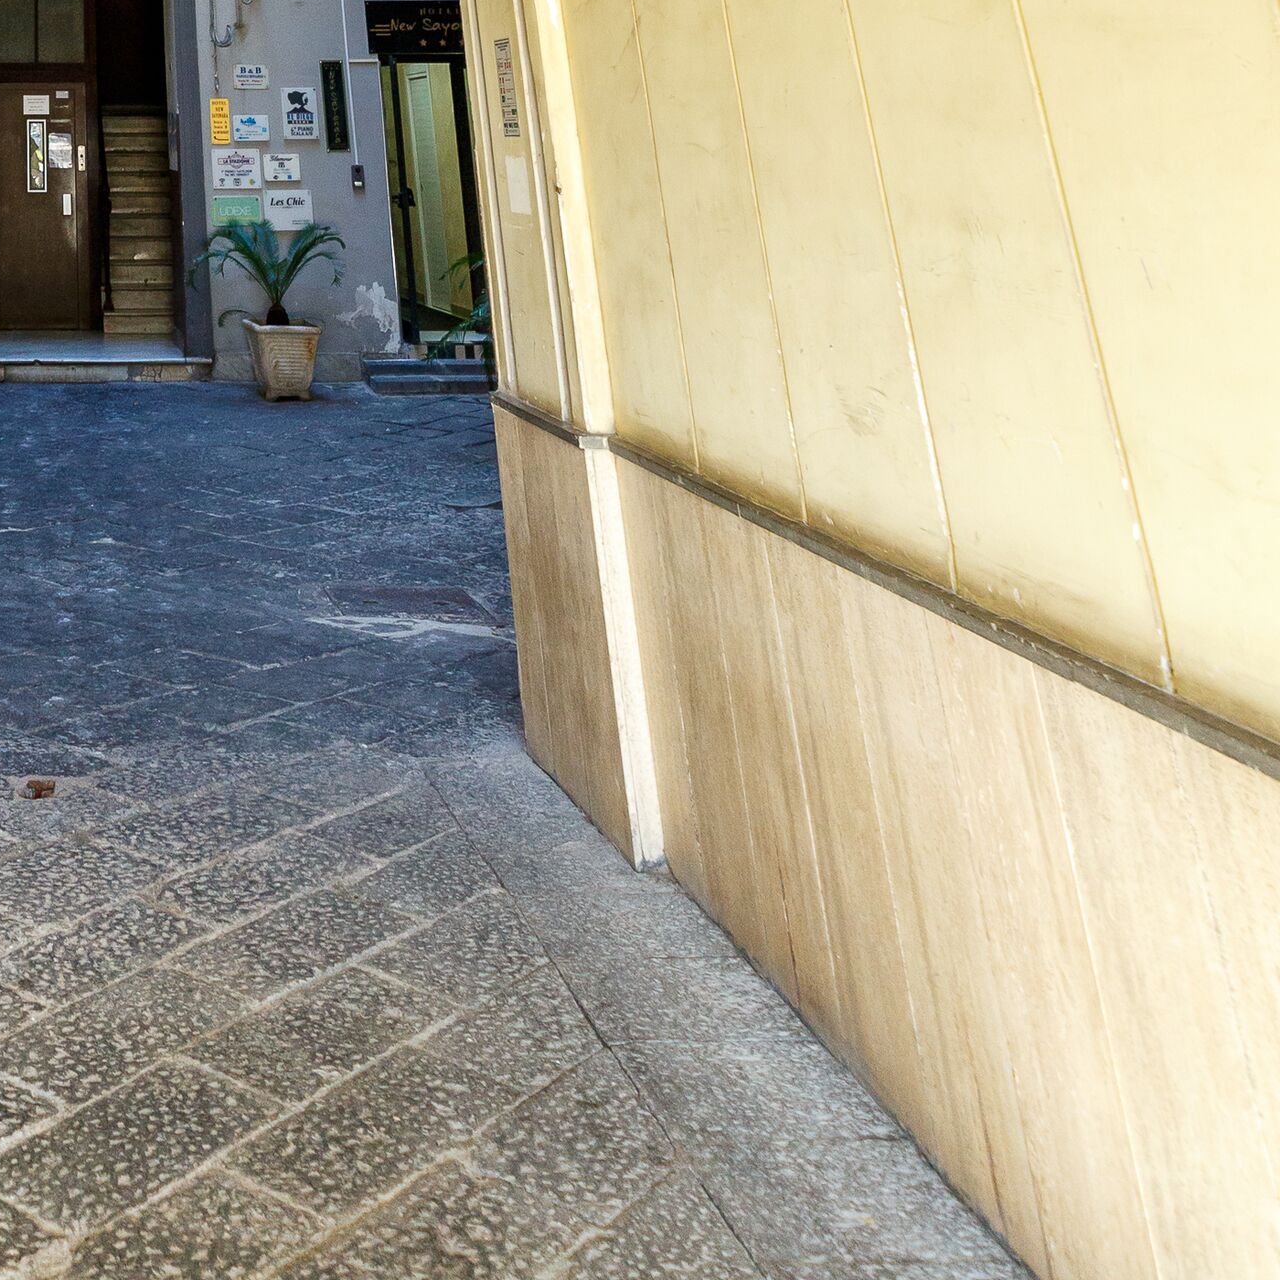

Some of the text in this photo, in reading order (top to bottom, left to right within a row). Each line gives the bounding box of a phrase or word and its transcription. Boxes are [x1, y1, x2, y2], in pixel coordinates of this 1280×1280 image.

[390, 18, 417, 32] New
[270, 197, 305, 206] Les Chic
[219, 206, 252, 216] UDEXE
